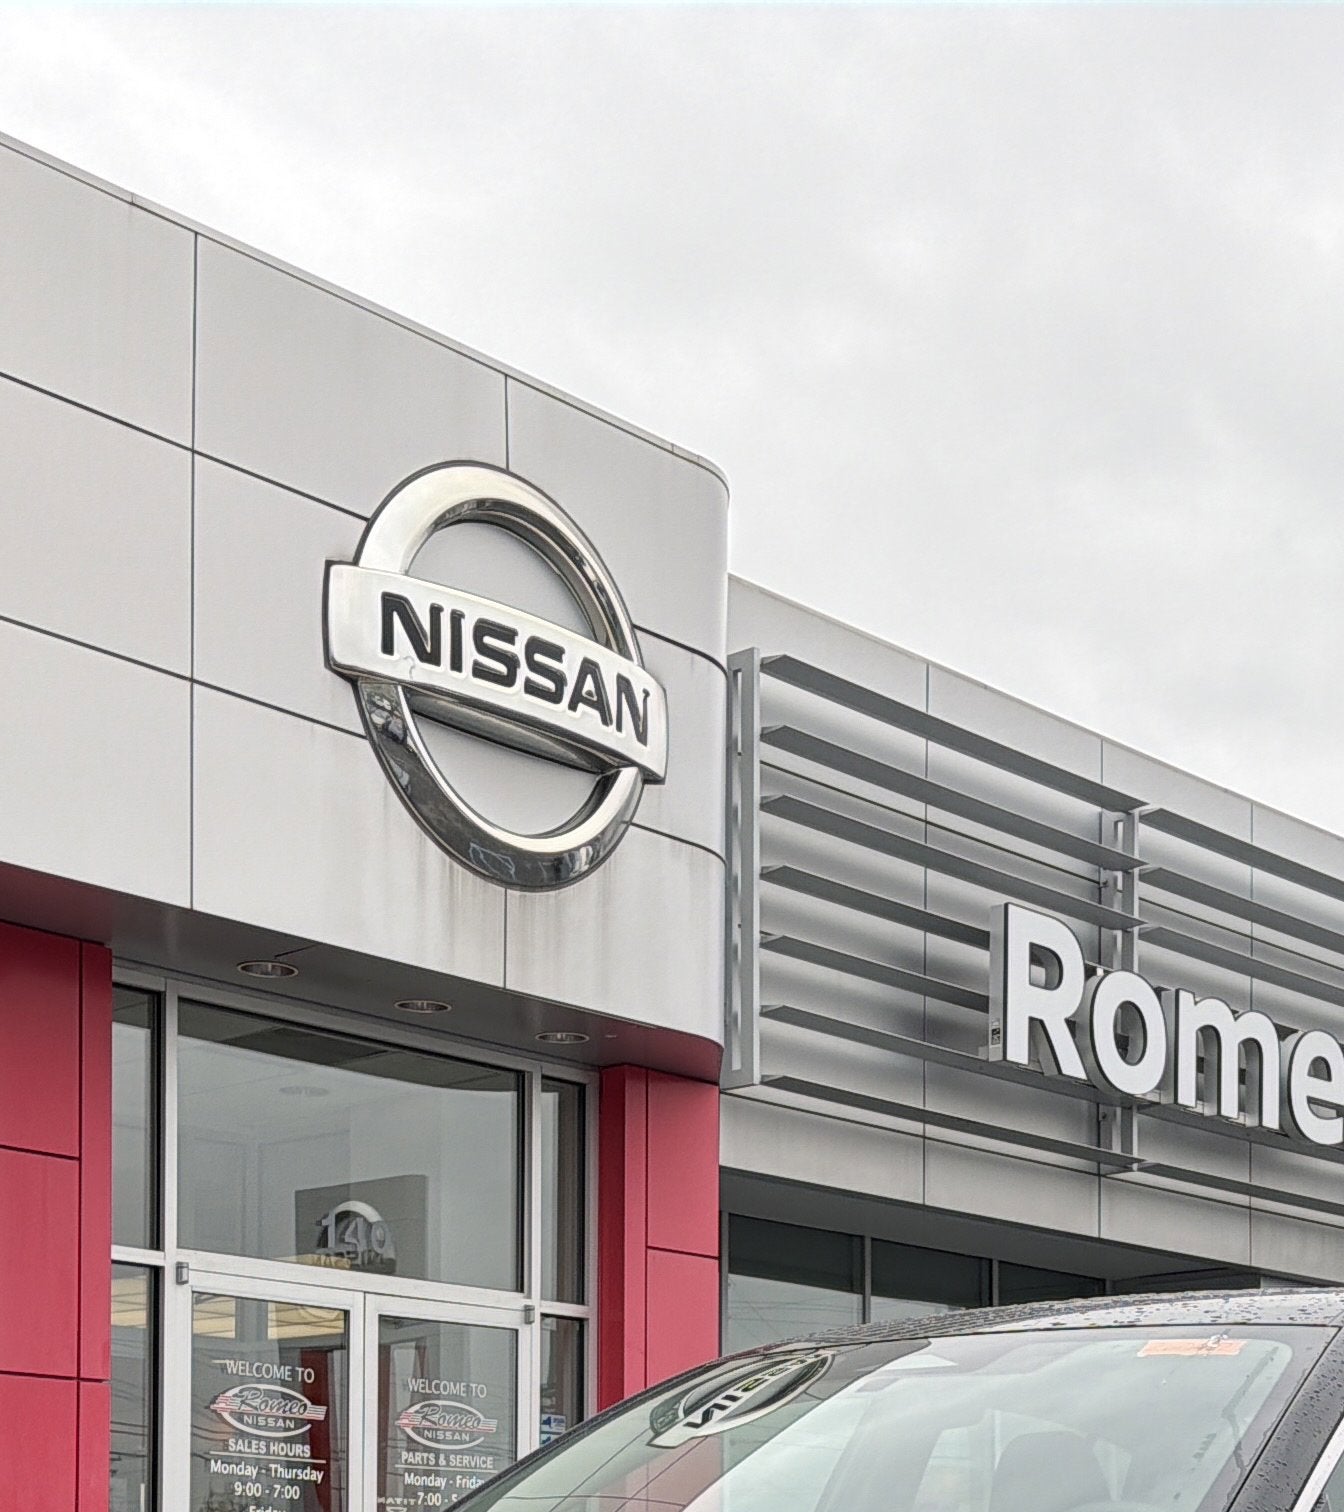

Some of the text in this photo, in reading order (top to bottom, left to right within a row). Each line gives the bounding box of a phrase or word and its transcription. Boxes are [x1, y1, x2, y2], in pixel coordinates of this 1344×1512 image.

[379, 590, 651, 747] NISSAN
[225, 1359, 315, 1383] WELCOME TO
[407, 1377, 487, 1398] WELCOME TO
[232, 1387, 308, 1415] Romeo
[243, 1415, 295, 1428] NISSAN
[416, 1403, 483, 1429] Romeo
[423, 1429, 470, 1441] NISSAN
[228, 1438, 311, 1457] SALES HOURS
[401, 1451, 494, 1469] PARTS & SERVICE
[210, 1459, 258, 1479] Monday
[269, 1463, 324, 1484] Thursday
[404, 1472, 447, 1490] Monday
[456, 1475, 484, 1489] Frida
[234, 1482, 262, 1497] 9:00
[273, 1484, 300, 1499] 7:00
[417, 1492, 442, 1506] 7:00
